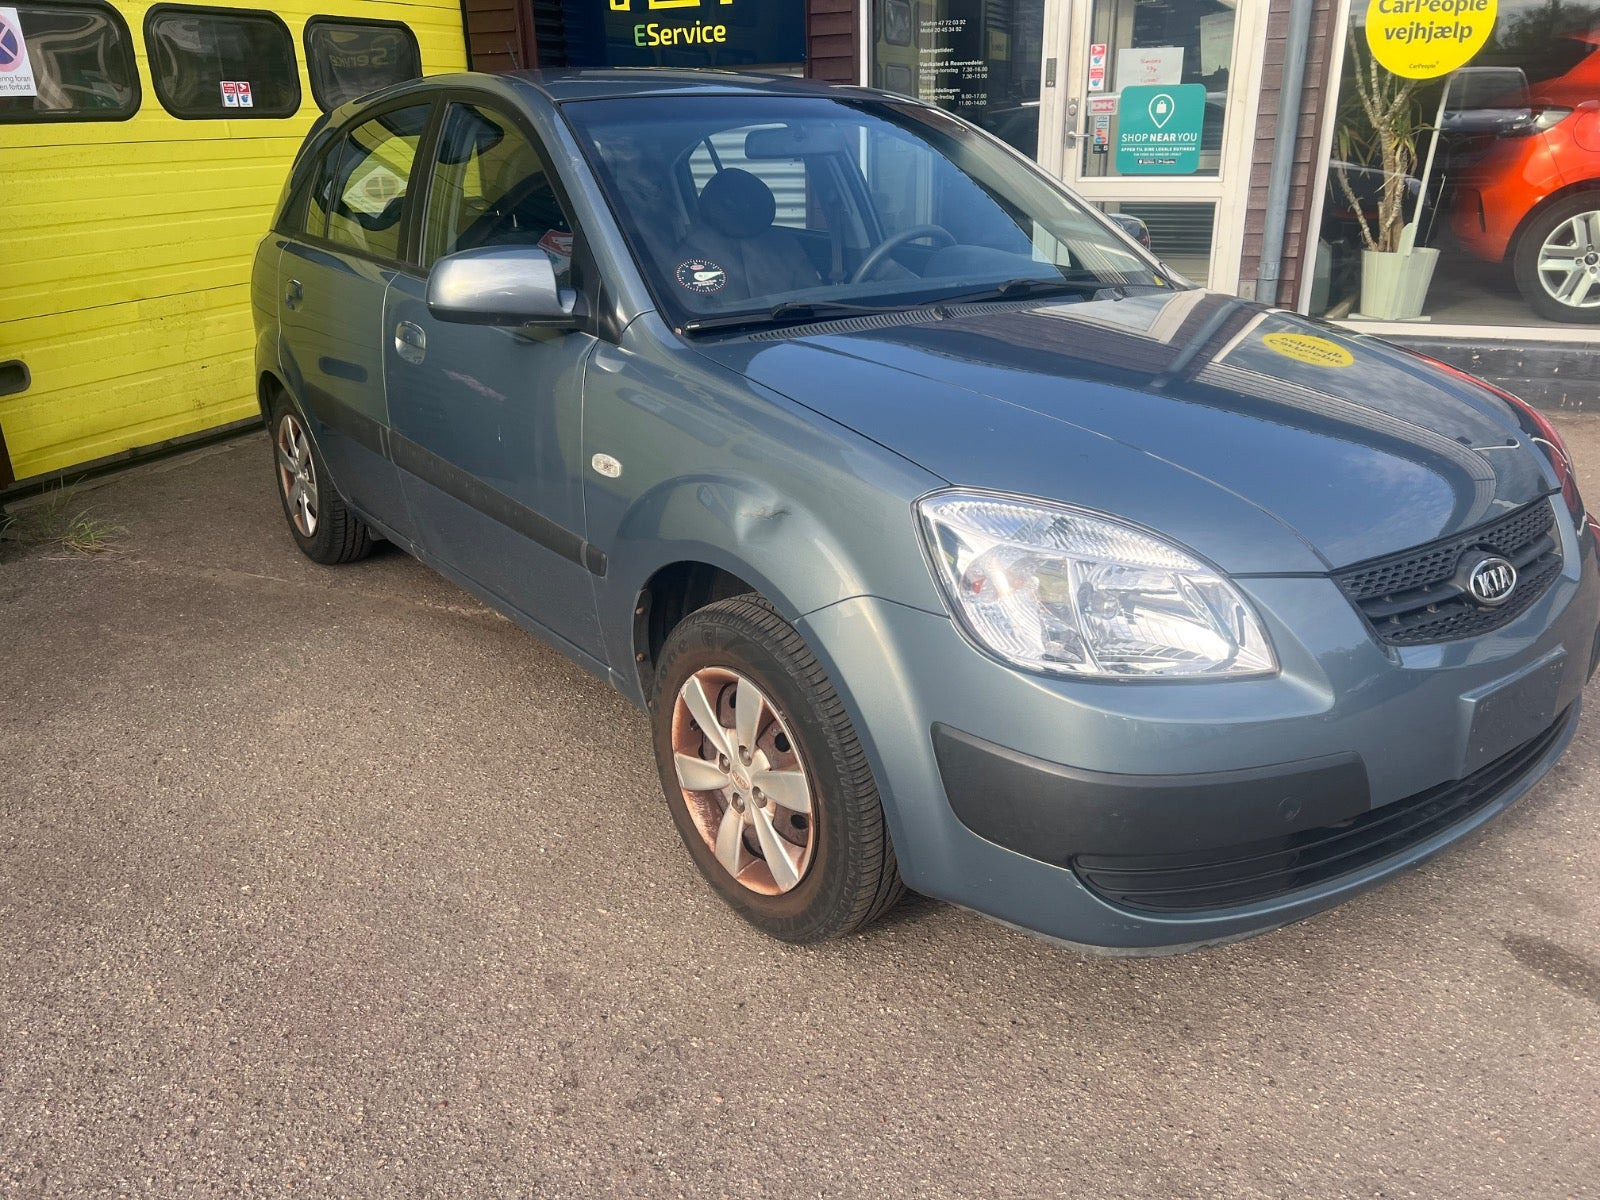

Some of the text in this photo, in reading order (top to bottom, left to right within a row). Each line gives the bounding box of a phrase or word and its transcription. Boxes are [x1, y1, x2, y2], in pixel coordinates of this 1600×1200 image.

[1379, 0, 1488, 16] CarPeople
[1384, 21, 1473, 44] vejhjælp
[1121, 132, 1198, 143] SHOP NEAR YOU
